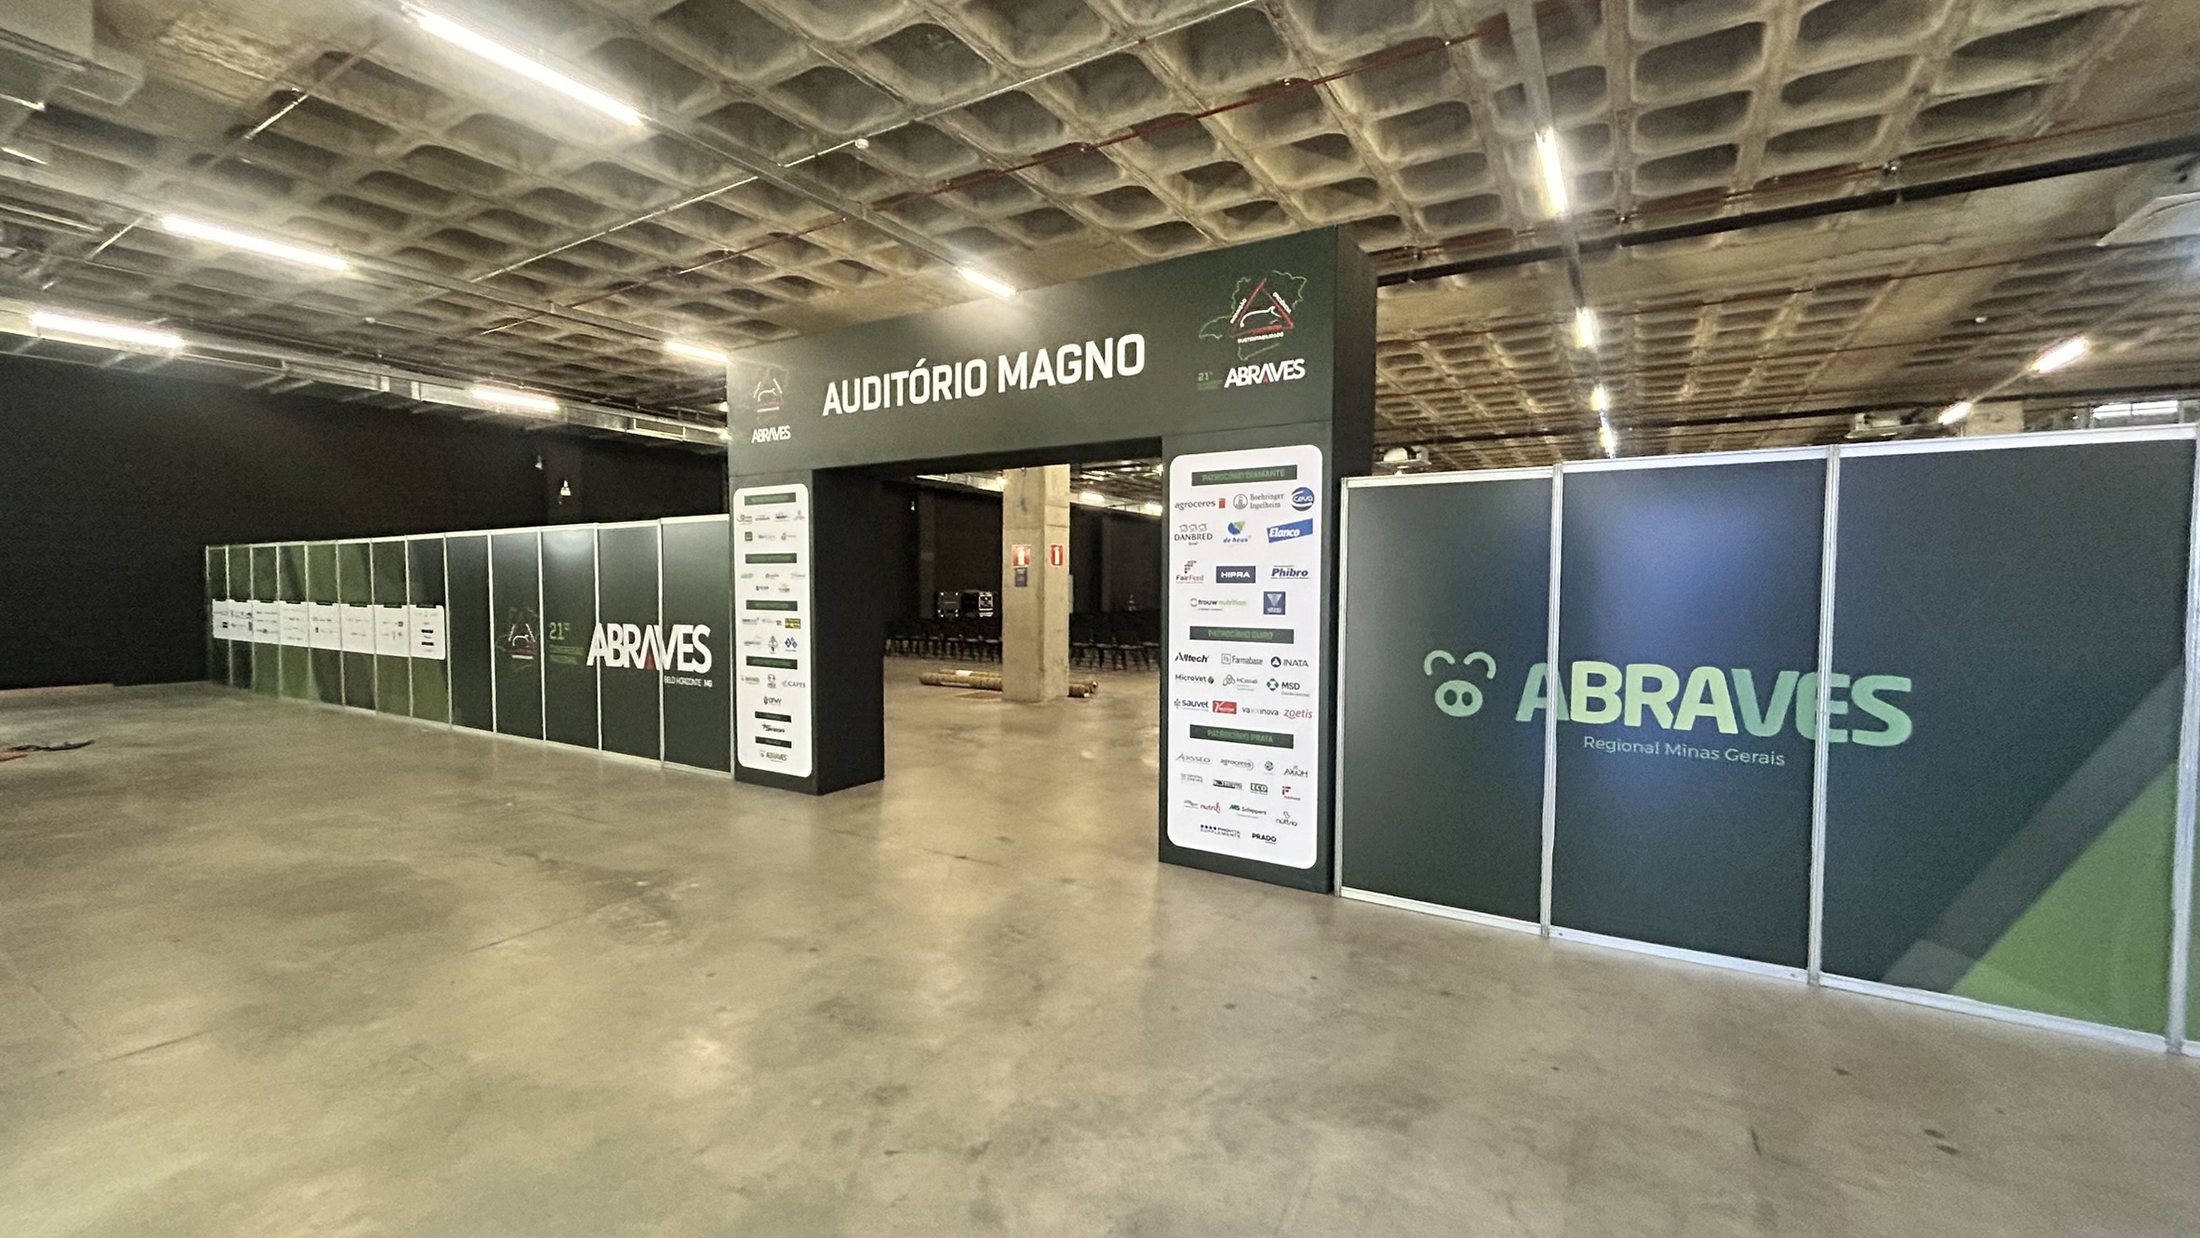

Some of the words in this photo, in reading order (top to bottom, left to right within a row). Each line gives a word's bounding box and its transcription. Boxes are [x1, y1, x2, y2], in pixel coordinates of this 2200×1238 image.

[822, 358, 988, 417] AUDITÓRIO
[998, 333, 1145, 394] MAGNO
[1224, 359, 1306, 388] ABRAVES
[751, 425, 791, 443] ABRAVES
[1250, 493, 1284, 501] Boehringer
[1174, 499, 1216, 511] agroceres
[1250, 502, 1281, 510] Ingelheim
[1174, 532, 1213, 541] DANBRED
[1269, 527, 1300, 538] Elanco
[1220, 571, 1251, 579] HIPRA
[1271, 568, 1308, 577] Phibro
[586, 622, 712, 674] ABRAVES
[1174, 652, 1210, 663] Alltech
[1283, 658, 1309, 668] INATA
[1175, 674, 1207, 683] MicroVet
[1281, 682, 1301, 690] MSD
[1515, 661, 1913, 747] ABRAVES
[1283, 708, 1313, 719] zoetis
[1584, 736, 1659, 756] Regional
[1664, 740, 1720, 761] Minas
[1724, 747, 1786, 767] Gerais
[1252, 832, 1277, 842] PRADO
